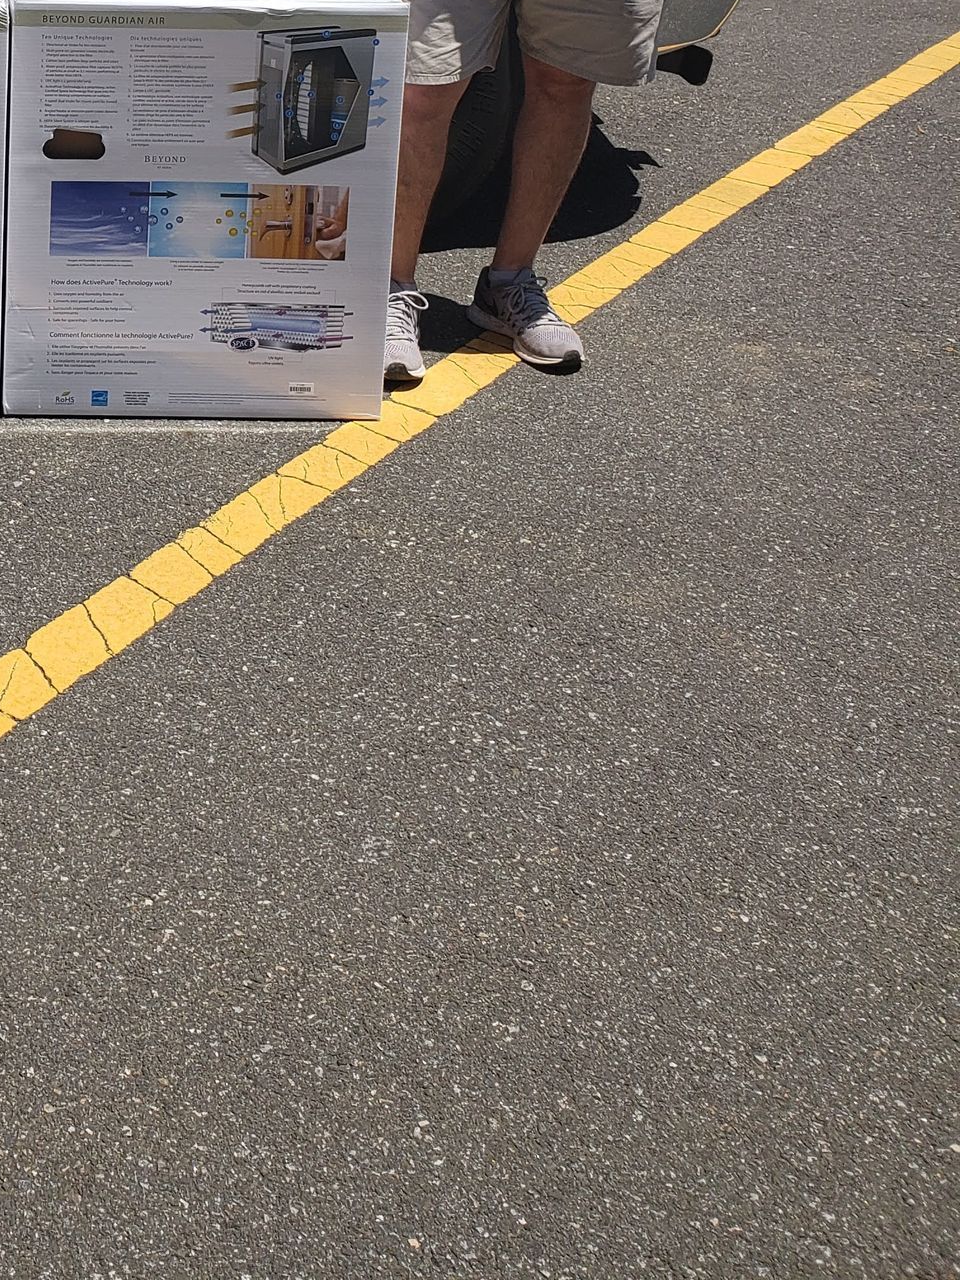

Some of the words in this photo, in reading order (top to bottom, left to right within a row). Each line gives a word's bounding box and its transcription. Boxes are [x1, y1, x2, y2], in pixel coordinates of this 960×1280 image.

[42, 15, 85, 24] BEYOND
[88, 16, 144, 25] GUARDIAN
[118, 279, 153, 287] Technology
[121, 332, 158, 340] technologie
